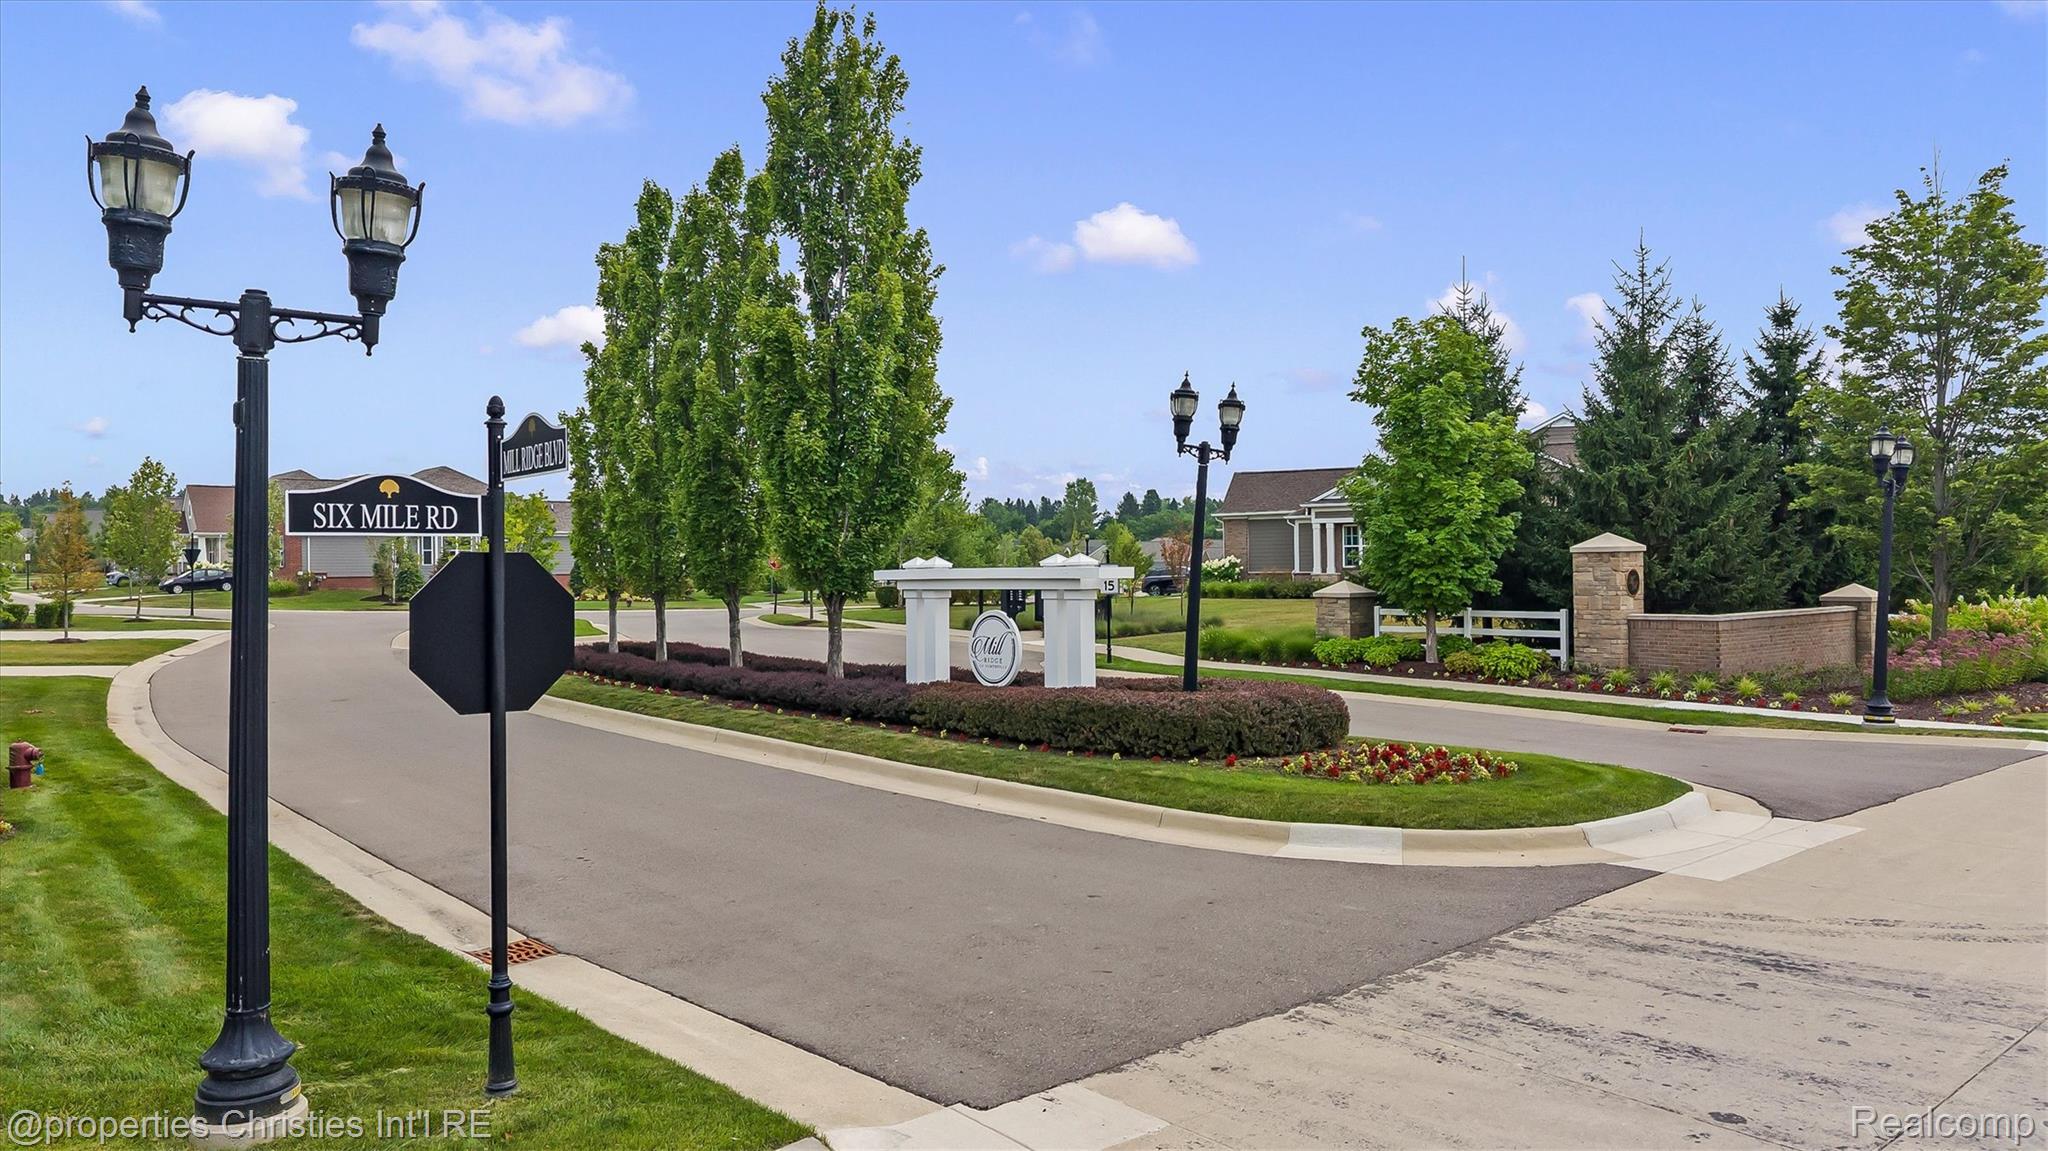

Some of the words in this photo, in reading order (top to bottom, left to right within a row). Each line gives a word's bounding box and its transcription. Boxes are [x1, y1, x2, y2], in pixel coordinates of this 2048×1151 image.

[503, 448, 520, 474] MILL
[521, 443, 543, 471] RIDGE
[544, 438, 564, 467] BLVD
[313, 503, 354, 529] SIX
[360, 504, 420, 530] MILE
[426, 506, 458, 530] RD
[1104, 581, 1115, 591] 15
[972, 631, 1016, 662] Mill
